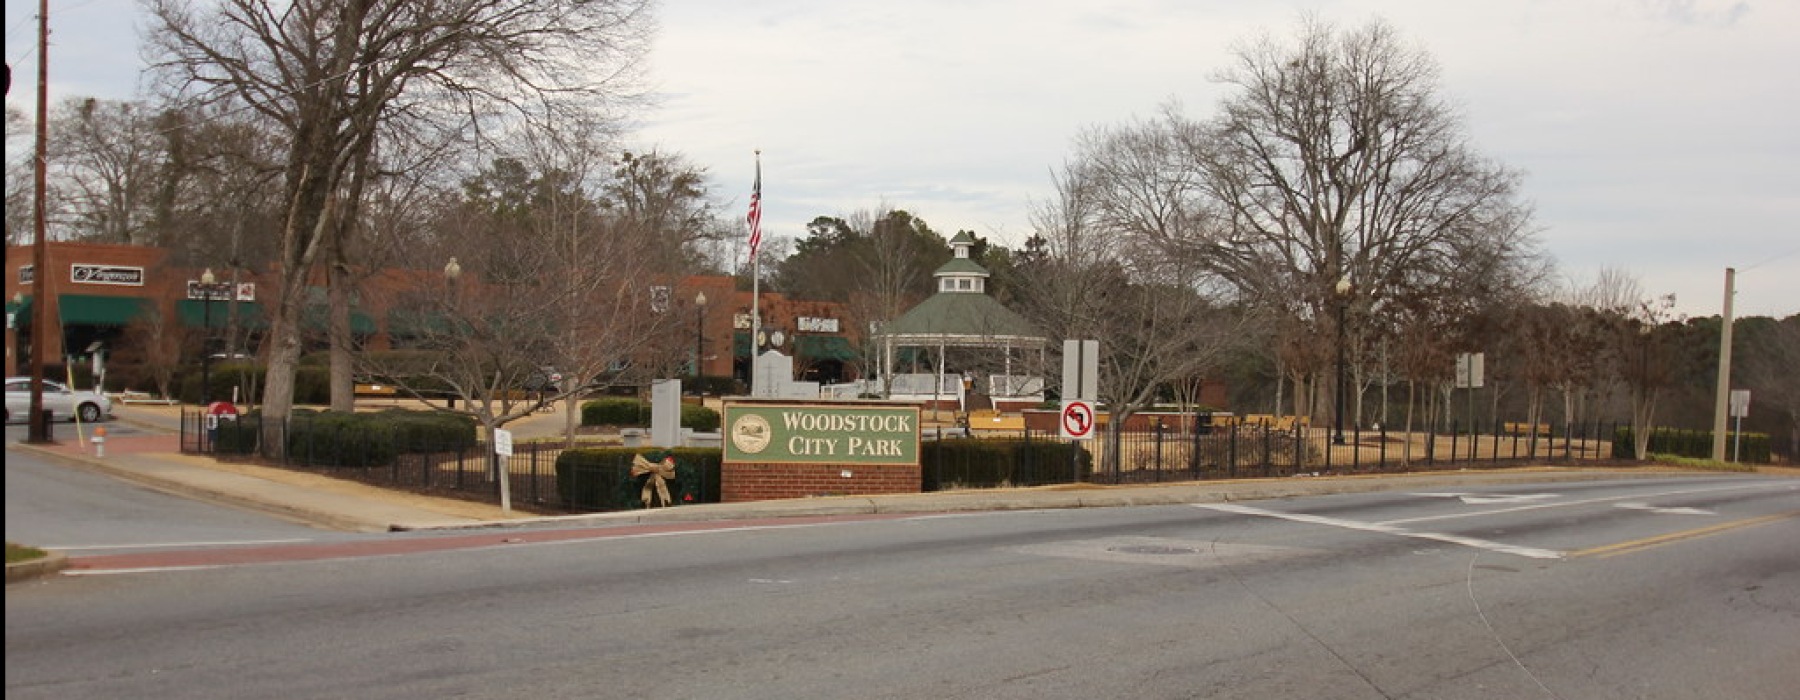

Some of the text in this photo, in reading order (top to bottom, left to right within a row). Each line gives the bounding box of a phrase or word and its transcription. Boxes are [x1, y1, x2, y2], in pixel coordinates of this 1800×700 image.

[782, 411, 911, 433] WOODSTOCK
[788, 436, 903, 456] CITY PARK
